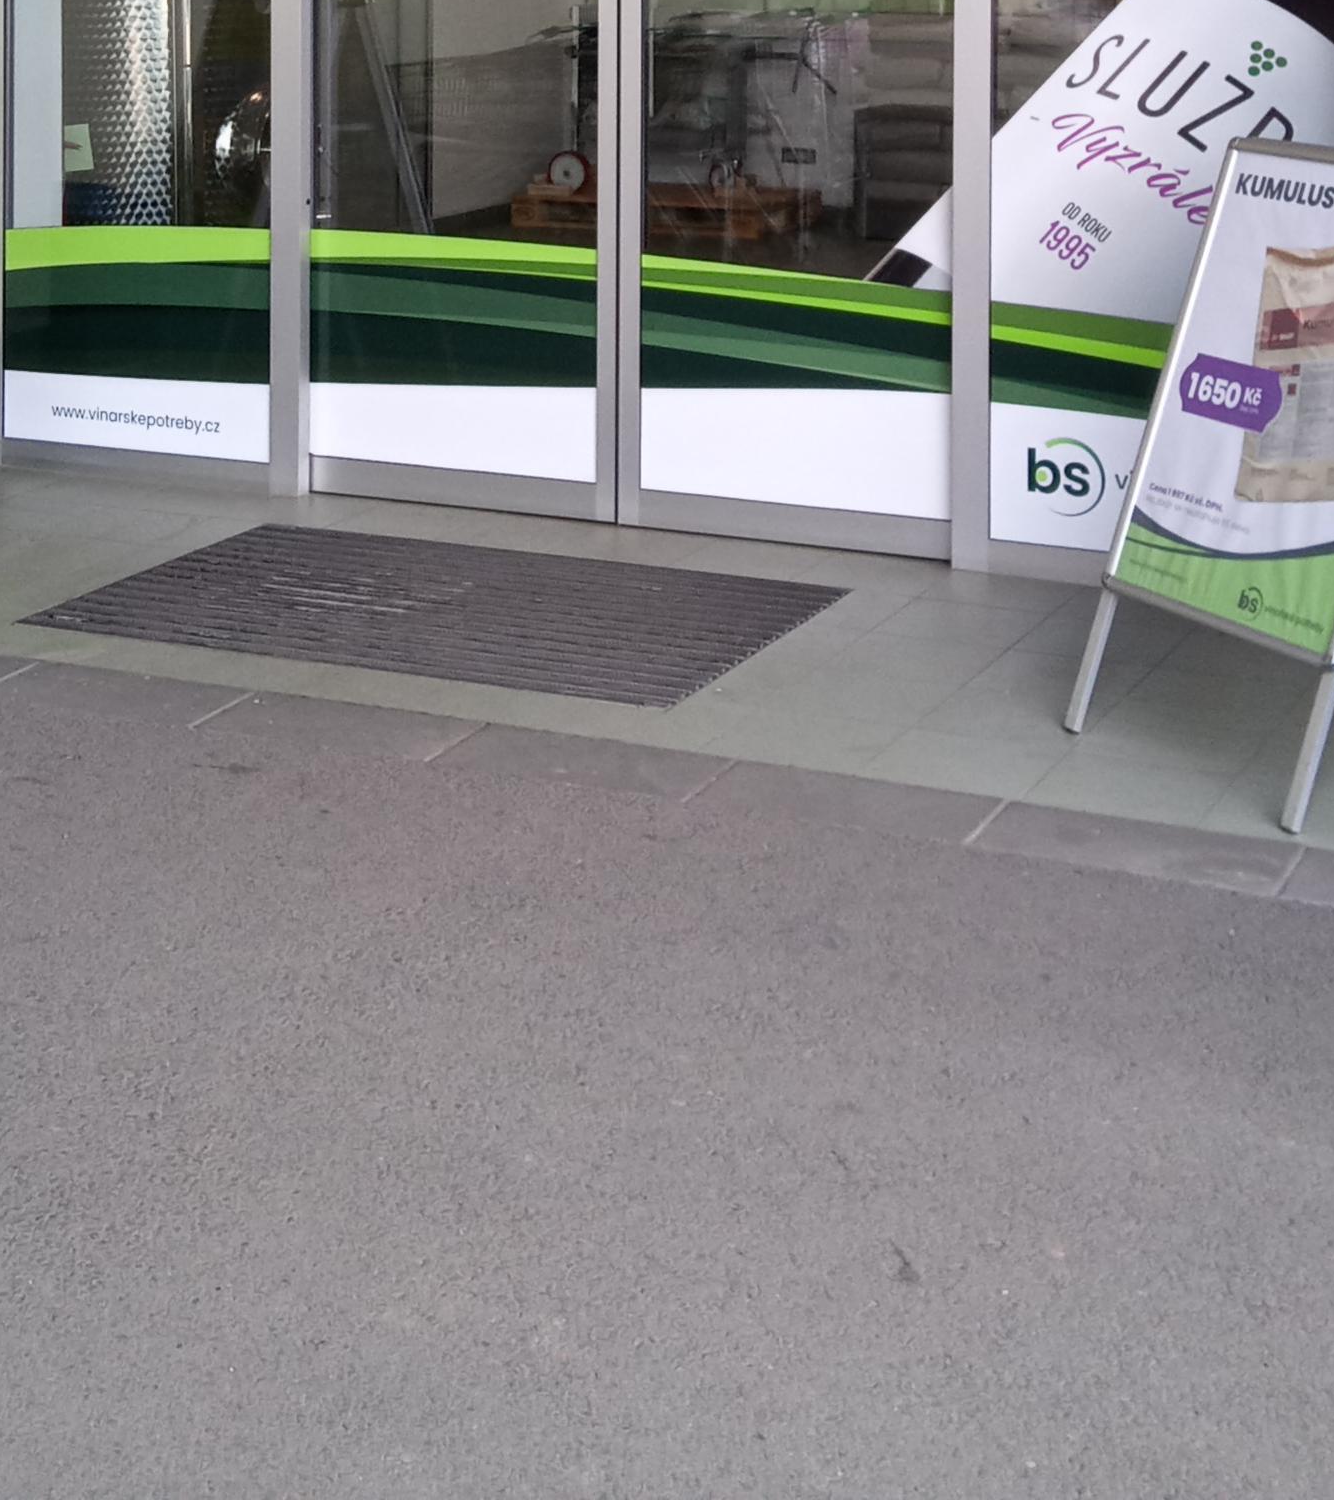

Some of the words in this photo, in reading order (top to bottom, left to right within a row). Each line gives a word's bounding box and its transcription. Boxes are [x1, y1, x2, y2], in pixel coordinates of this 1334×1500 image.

[1051, 111, 1215, 227] Vyzrále
[1235, 173, 1334, 210] KUMULUS
[1061, 202, 1081, 222] OD
[1077, 207, 1112, 244] ROKU
[1038, 219, 1098, 272] 1995
[1188, 372, 1242, 409] 1650
[1242, 386, 1263, 406] Kč
[51, 404, 221, 435] www.vinarskepotreby.cz
[1027, 446, 1091, 498] bs
